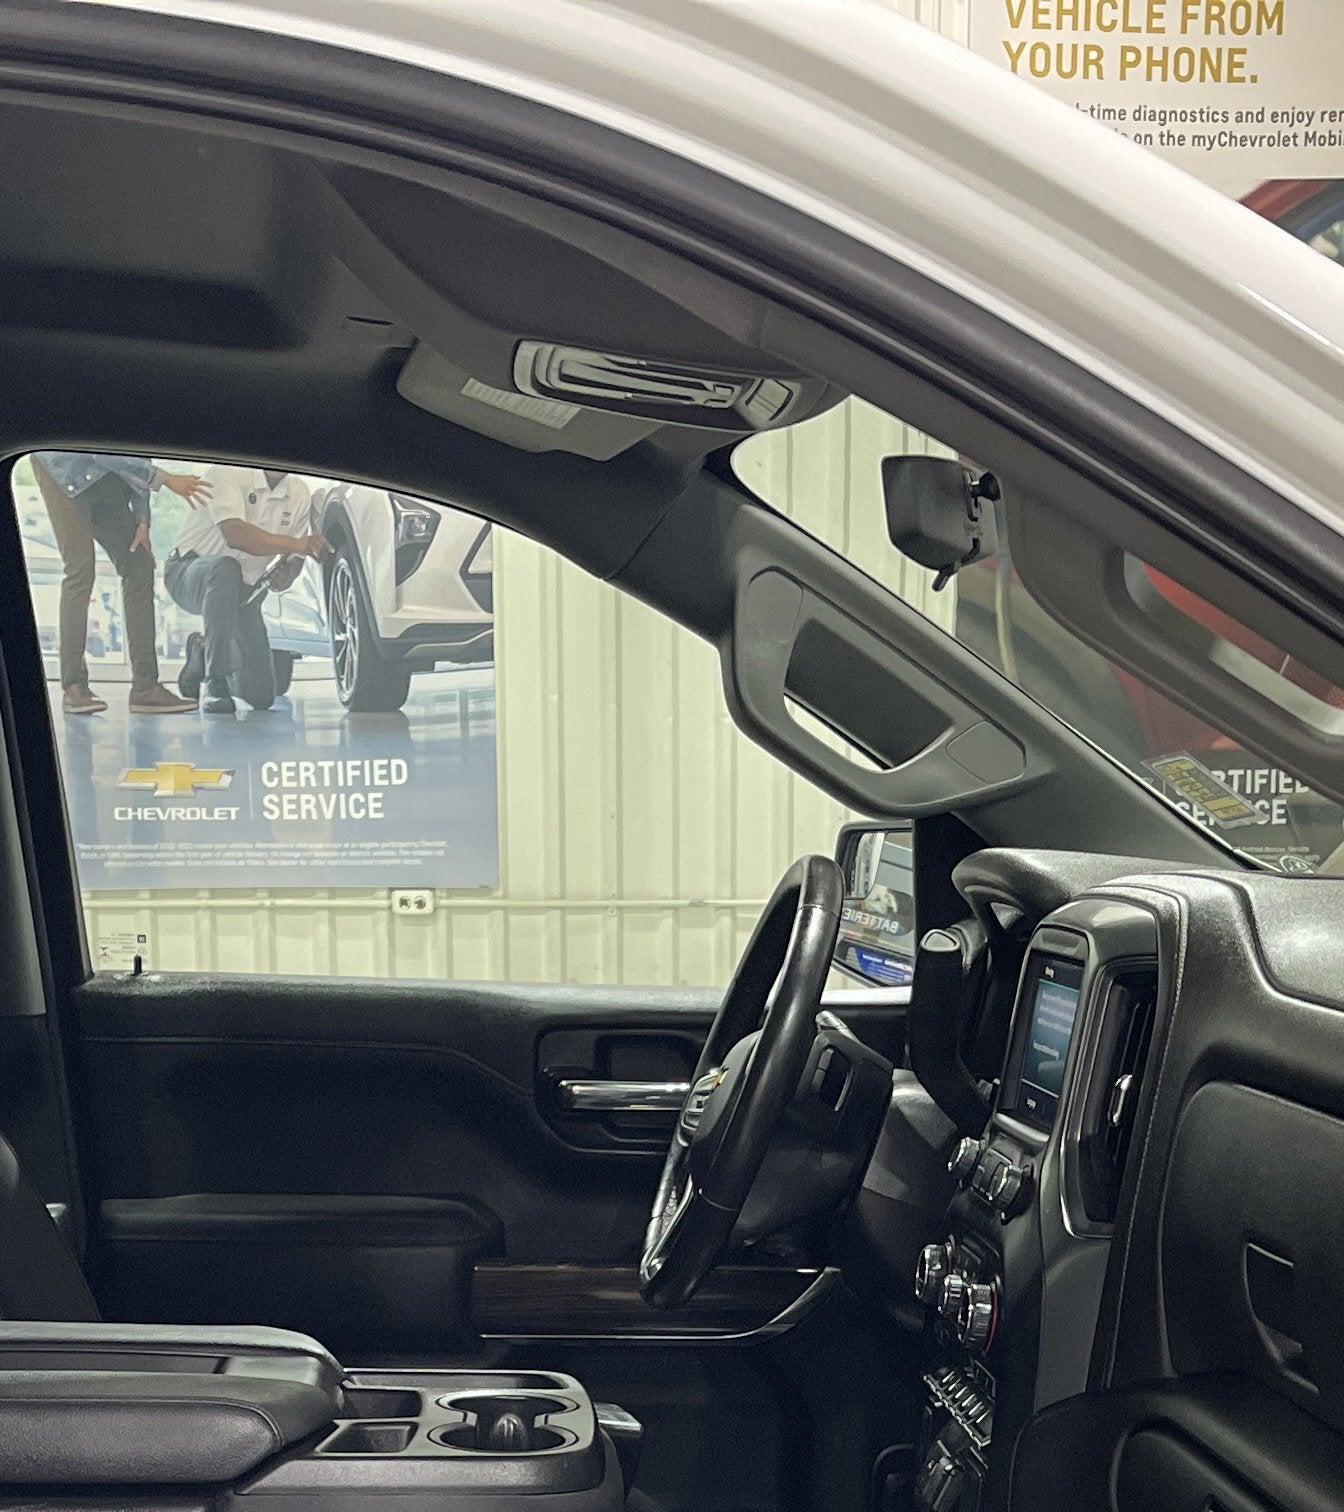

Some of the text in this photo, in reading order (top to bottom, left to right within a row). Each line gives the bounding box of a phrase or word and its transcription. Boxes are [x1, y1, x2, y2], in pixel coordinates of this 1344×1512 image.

[1006, 0, 1285, 36] VEHICLE FROM
[1002, 40, 1258, 84] YOUR PHONE.
[1132, 105, 1229, 127] diagnostics
[1235, 106, 1265, 123] and
[1270, 106, 1315, 128] enjoy
[1133, 132, 1153, 146] on
[1158, 130, 1186, 147] the
[1191, 130, 1299, 151] myChevrolet
[261, 758, 409, 789] CERTIFIED
[113, 806, 241, 821] CHEVROLET
[262, 792, 385, 821] SERVICE
